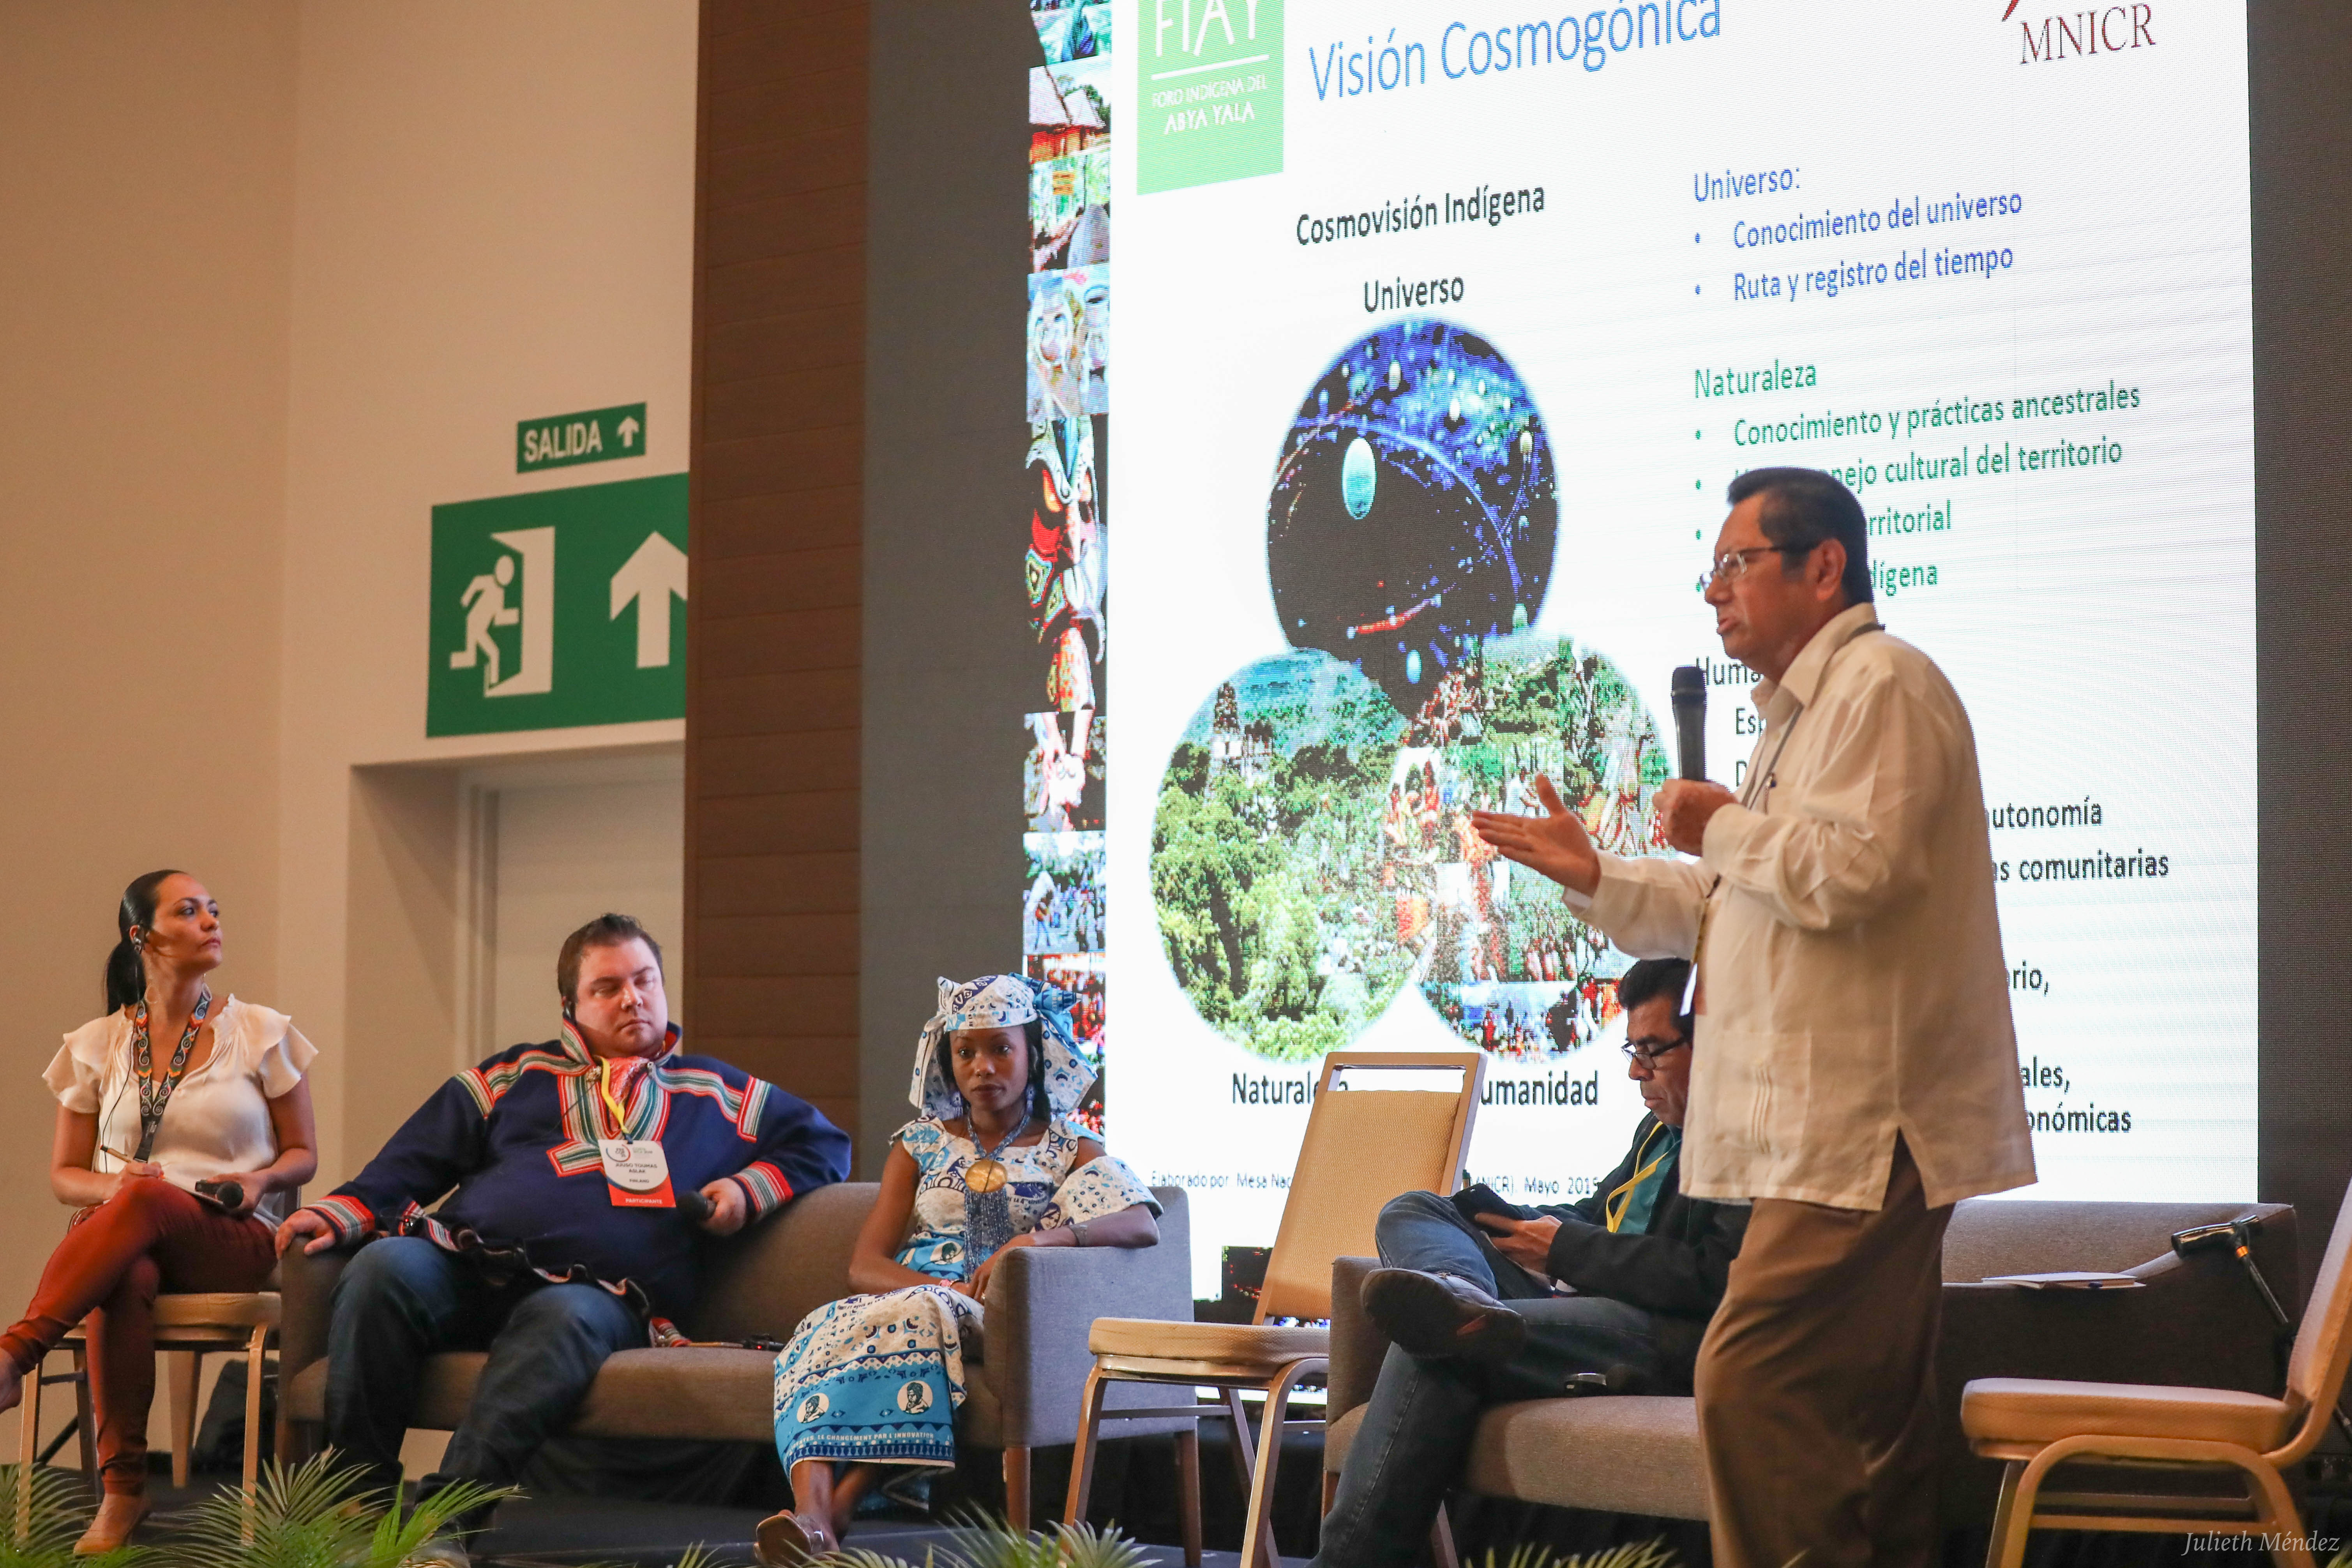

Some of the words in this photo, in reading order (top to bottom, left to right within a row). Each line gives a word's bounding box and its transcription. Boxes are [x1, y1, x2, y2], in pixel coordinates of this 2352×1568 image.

[1309, 28, 1426, 101] Visión
[1441, 0, 1720, 79] Cosmogónica
[2020, 4, 2156, 65] MNICR
[1164, 109, 1208, 134] ABYA
[1213, 101, 1255, 125] YALA
[1694, 168, 1800, 203] Universo:
[1296, 194, 1437, 246] Cosmovisión
[1445, 185, 1545, 228] Indígena
[1734, 209, 1881, 249] Conocimiento
[1888, 196, 1919, 229] del
[1927, 192, 2022, 224] universo
[1364, 277, 1464, 313] Universo
[1734, 272, 1781, 301] Ruta
[1787, 274, 1799, 302] y
[1806, 260, 1888, 298] registro
[1895, 248, 1926, 281] del
[1934, 247, 2013, 279] tiempo
[1695, 359, 1817, 398] Naturaleza
[1734, 410, 1882, 447] Conocimiento
[1888, 411, 1900, 440] y
[1907, 396, 2004, 438] prácticas
[2012, 380, 2140, 420] ancestrales
[524, 419, 603, 464] SALIDA
[1832, 457, 1878, 494] nejo
[1885, 446, 1968, 483] cultural
[1976, 442, 2010, 475] del
[2018, 435, 2122, 471] territorio
[1987, 795, 2103, 829] utonomía
[2019, 848, 2169, 883] comunitarias
[1464, 1070, 1599, 1105] umanidad
[1524, 1176, 1559, 1197] Mayo
